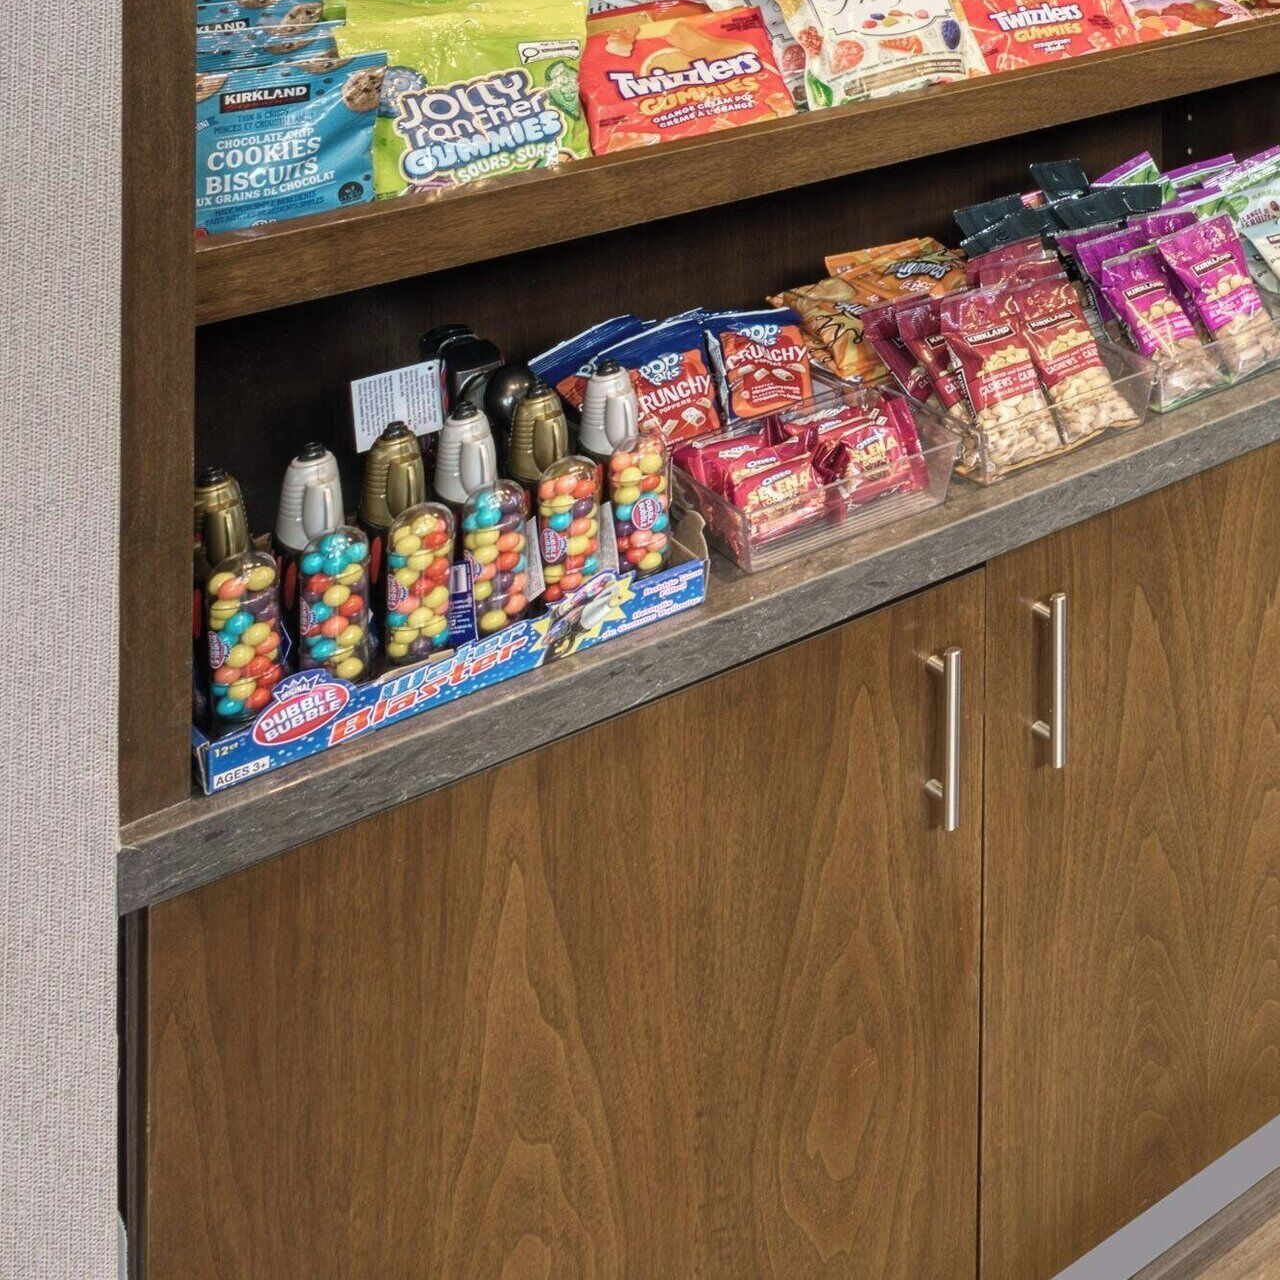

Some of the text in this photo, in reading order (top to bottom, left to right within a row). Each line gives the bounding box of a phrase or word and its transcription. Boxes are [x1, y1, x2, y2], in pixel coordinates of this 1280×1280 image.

[989, 3, 1083, 31] Twizzlers
[1014, 23, 1082, 42] GUMMIES
[609, 53, 762, 99] Twizzlers
[224, 86, 307, 105] KIRKLAND
[400, 74, 523, 129] JOLLY
[640, 77, 759, 116] GUMMIES
[208, 137, 321, 171] COOKIES
[217, 134, 282, 150] CHOCOLATE
[404, 110, 561, 175] GUMMIES
[206, 156, 318, 195] BISCUITS
[216, 171, 335, 204] GRAINS DE CHOCOLAT
[1196, 253, 1232, 272] KIRKLAND
[1126, 281, 1164, 299] KIRKLAND
[968, 326, 1010, 342] KIRKLAND
[1030, 312, 1072, 329] KIRKLAND
[329, 637, 526, 745] Blaster
[261, 689, 338, 731] DUBBLE
[265, 700, 341, 742] BUBBLE
[216, 759, 267, 786] AGES 3+
